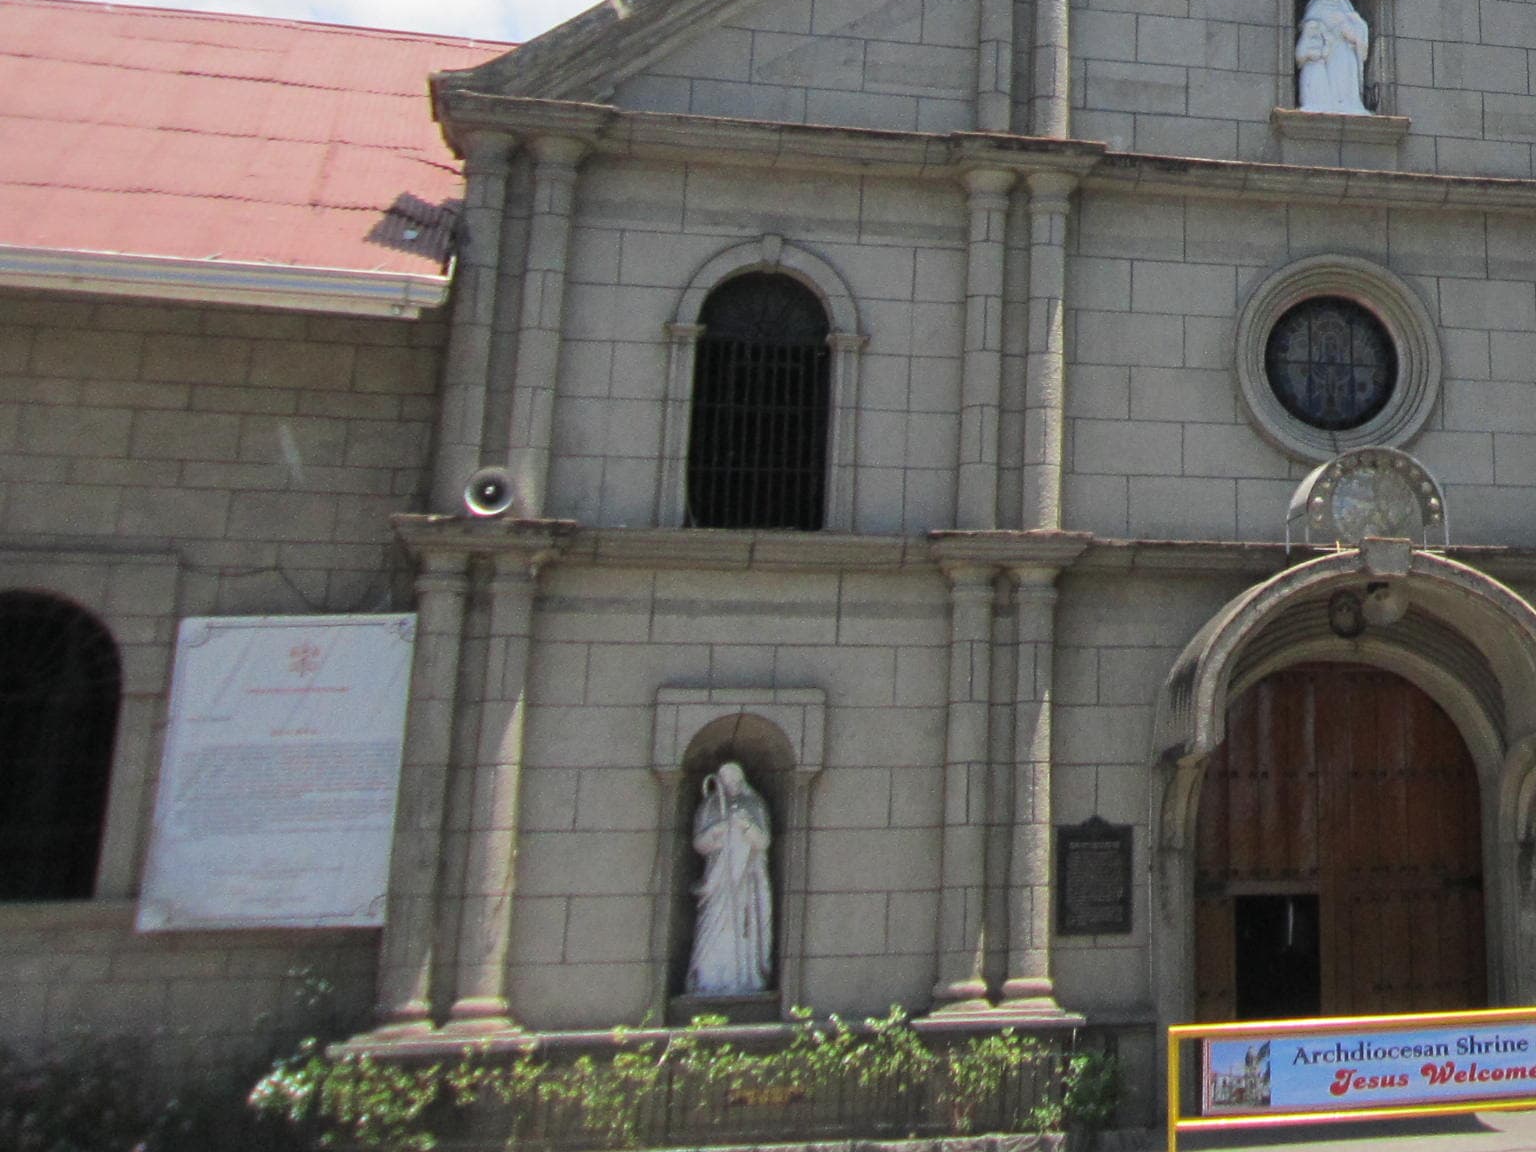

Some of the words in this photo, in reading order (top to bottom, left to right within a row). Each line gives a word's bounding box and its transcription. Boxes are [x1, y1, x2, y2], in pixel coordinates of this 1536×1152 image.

[1292, 1041, 1449, 1066] Archdiocesan
[1456, 1034, 1529, 1056] Shrine
[1329, 1068, 1410, 1096] Jesus
